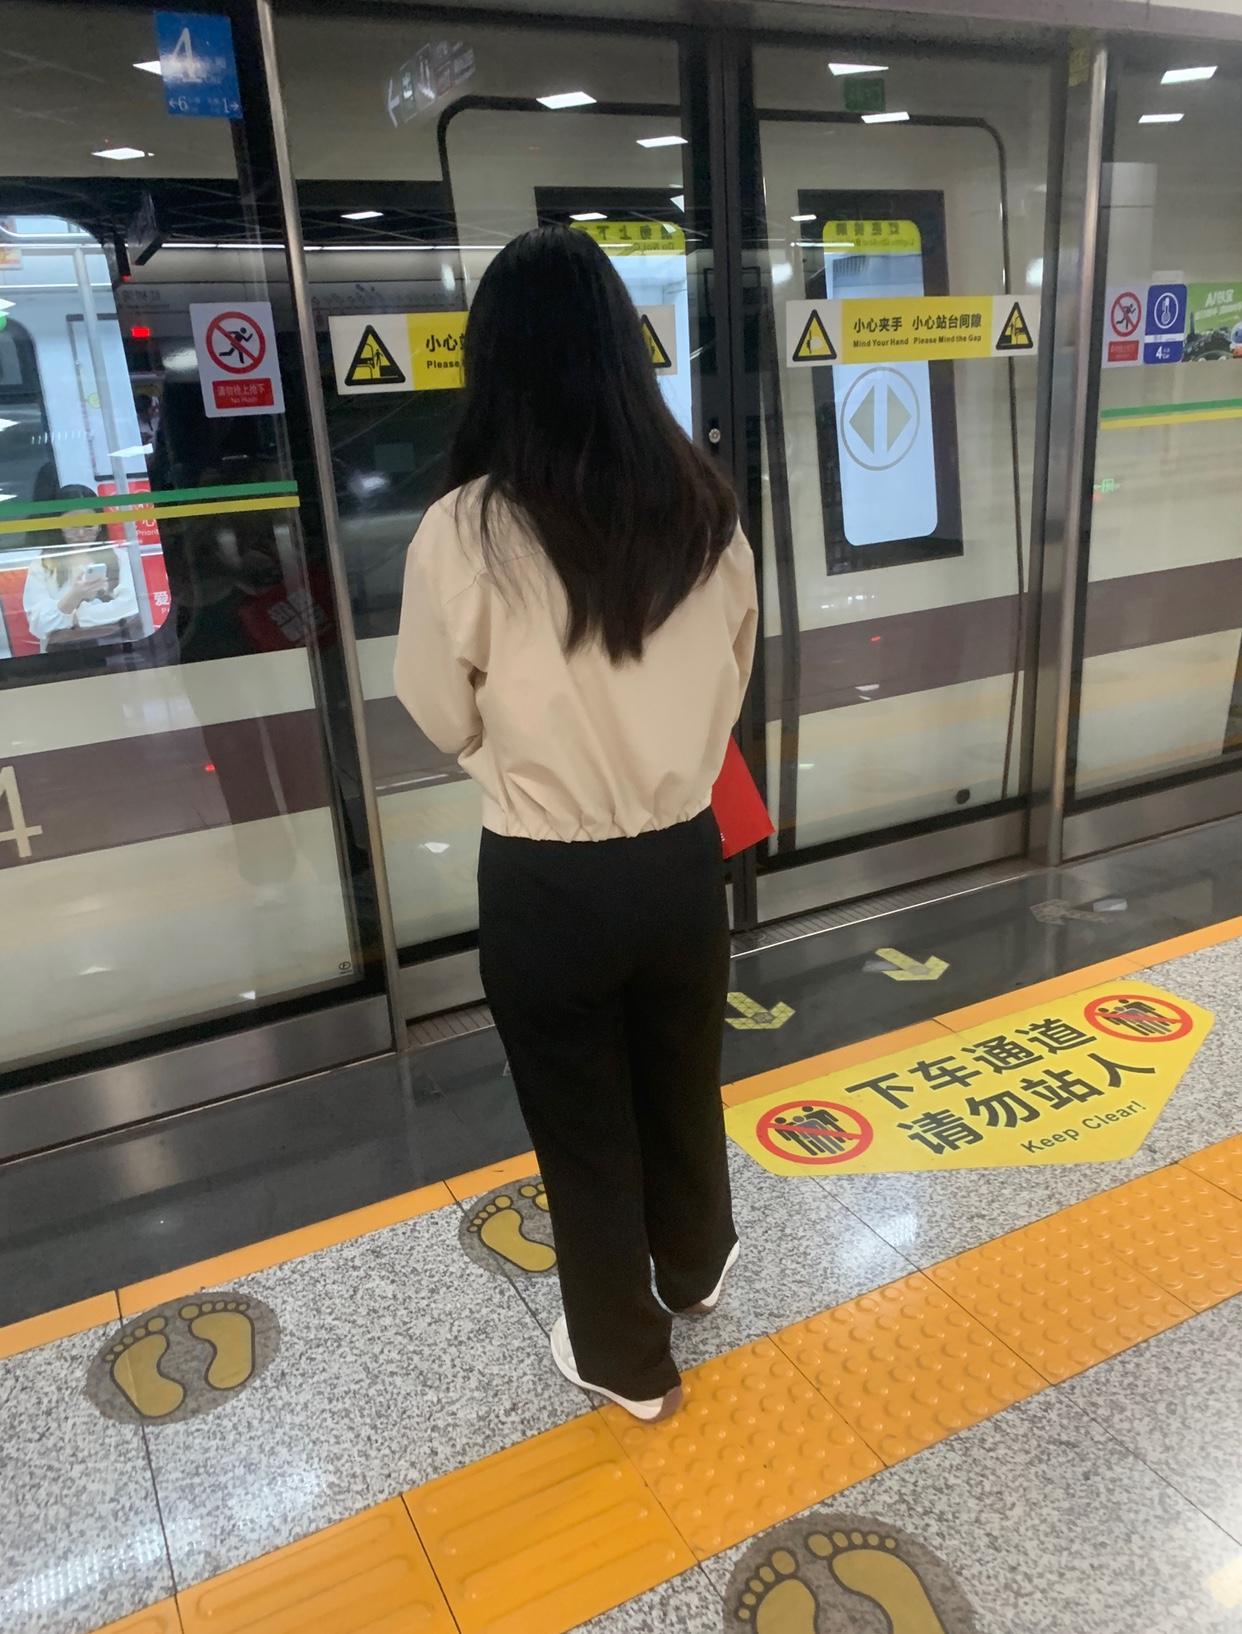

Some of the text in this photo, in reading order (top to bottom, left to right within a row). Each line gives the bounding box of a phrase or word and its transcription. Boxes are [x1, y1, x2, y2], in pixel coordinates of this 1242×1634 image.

[169, 27, 203, 82] 4
[853, 313, 982, 334] 小心夹手 小心站台间隙
[853, 334, 982, 348] Mind Your Hand Please Mind the Gap
[426, 360, 460, 369] Please
[0, 766, 43, 857] 4
[844, 1018, 1098, 1110] 下车通道
[896, 1053, 1156, 1155] 请勿站人
[1020, 1100, 1147, 1154] Keep Clear!
